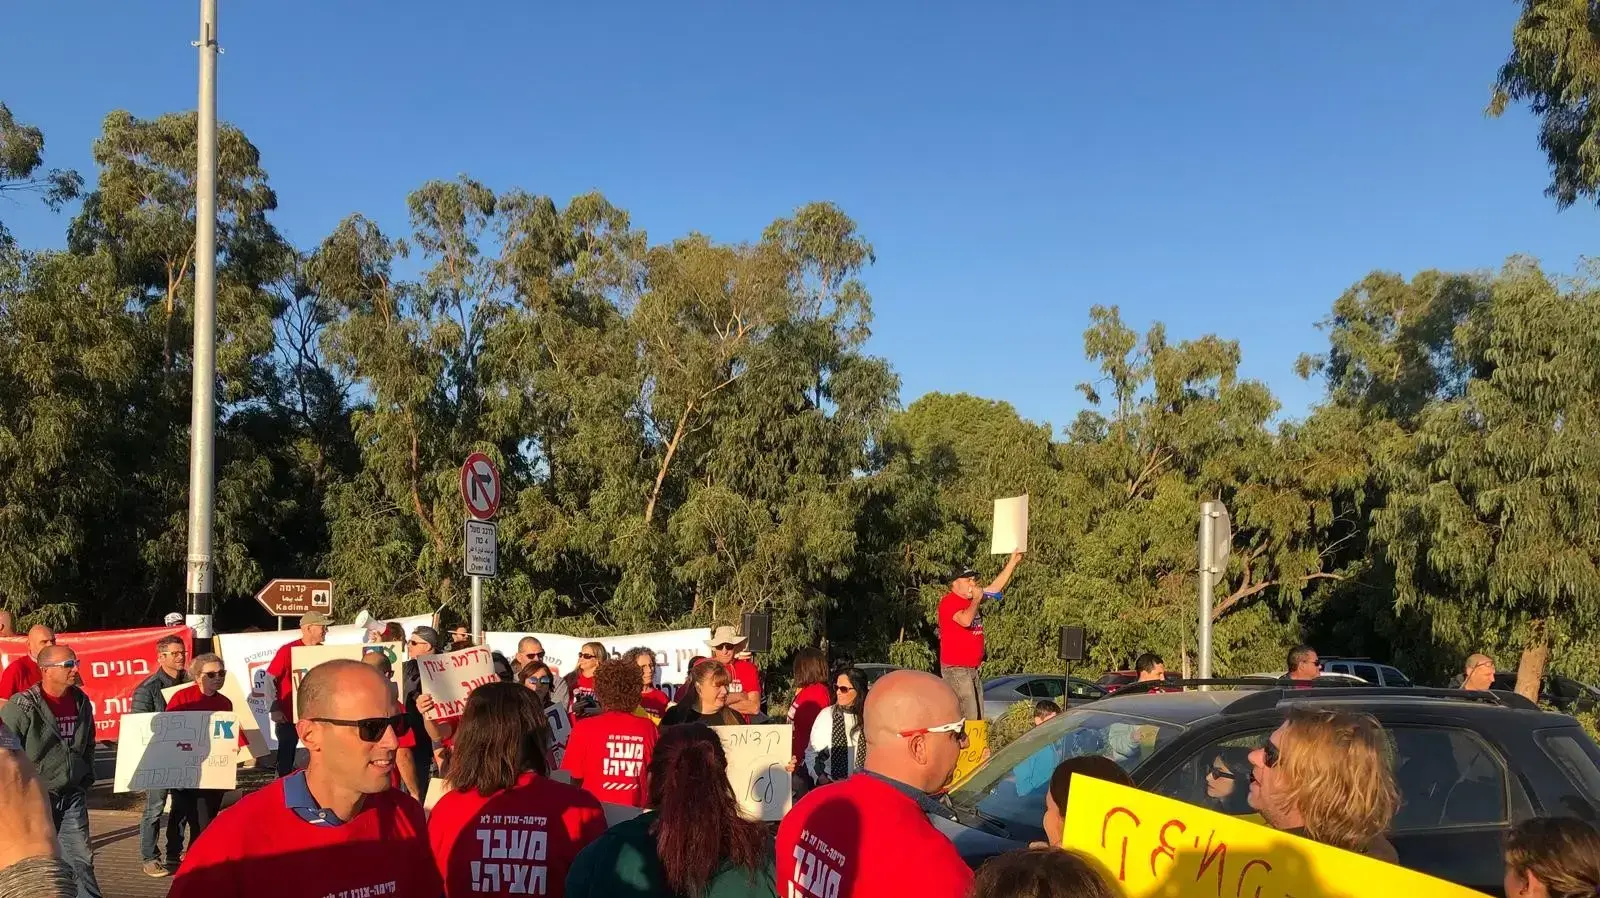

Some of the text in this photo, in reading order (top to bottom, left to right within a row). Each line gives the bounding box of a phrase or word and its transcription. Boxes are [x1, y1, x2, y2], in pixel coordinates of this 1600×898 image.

[472, 555, 490, 563] Vehicle
[279, 584, 306, 593] קדימה
[275, 603, 309, 611] Kadima
[91, 659, 150, 678] בונים
[605, 742, 644, 760] מעבר
[745, 763, 779, 804] לא
[480, 814, 548, 827] קדימה-צורן זה לא
[476, 829, 548, 860] מעבר
[470, 861, 548, 895] חציה!
[793, 844, 842, 898] מעבר
